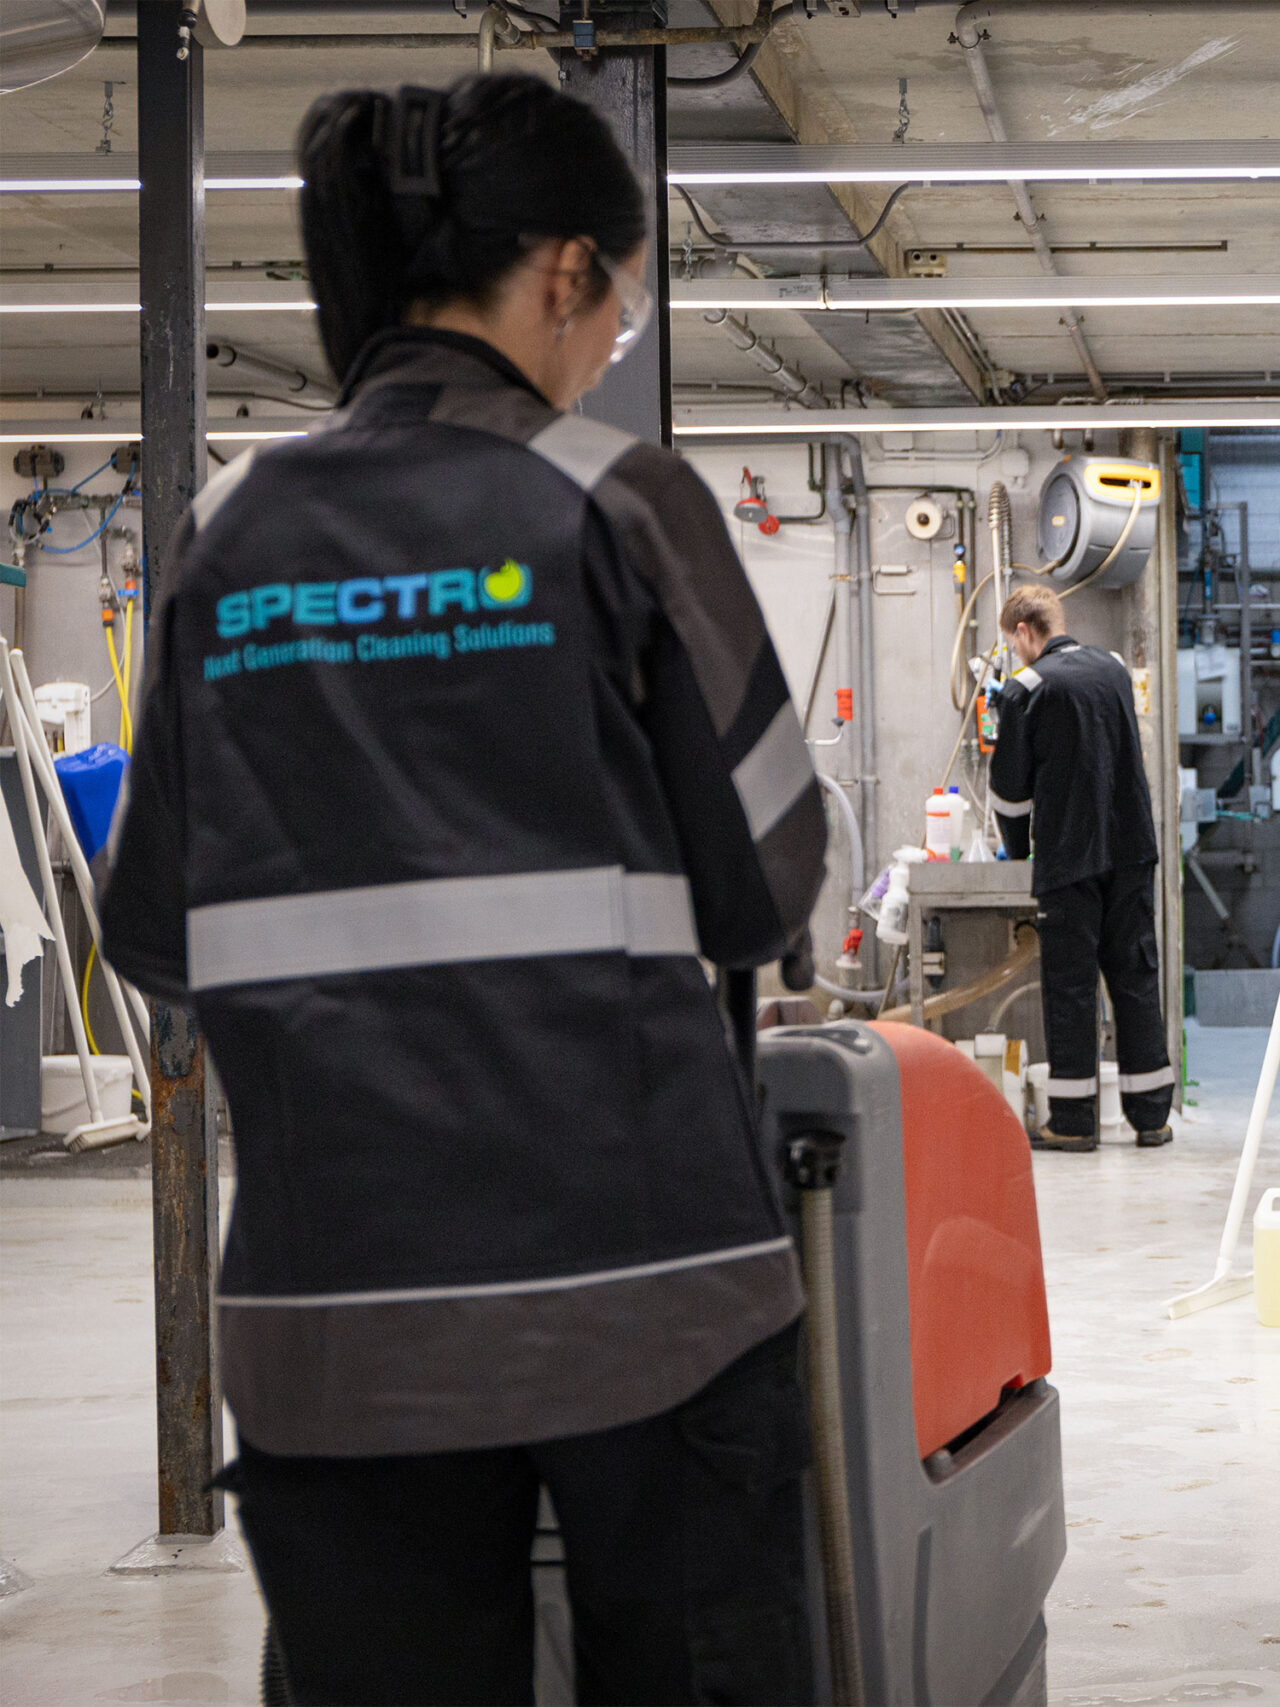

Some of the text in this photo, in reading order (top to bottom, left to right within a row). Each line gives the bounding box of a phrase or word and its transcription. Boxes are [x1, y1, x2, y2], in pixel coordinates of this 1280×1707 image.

[216, 562, 532, 638] SPECTRO
[203, 620, 555, 681] Next Generation Cleaning Solutions
